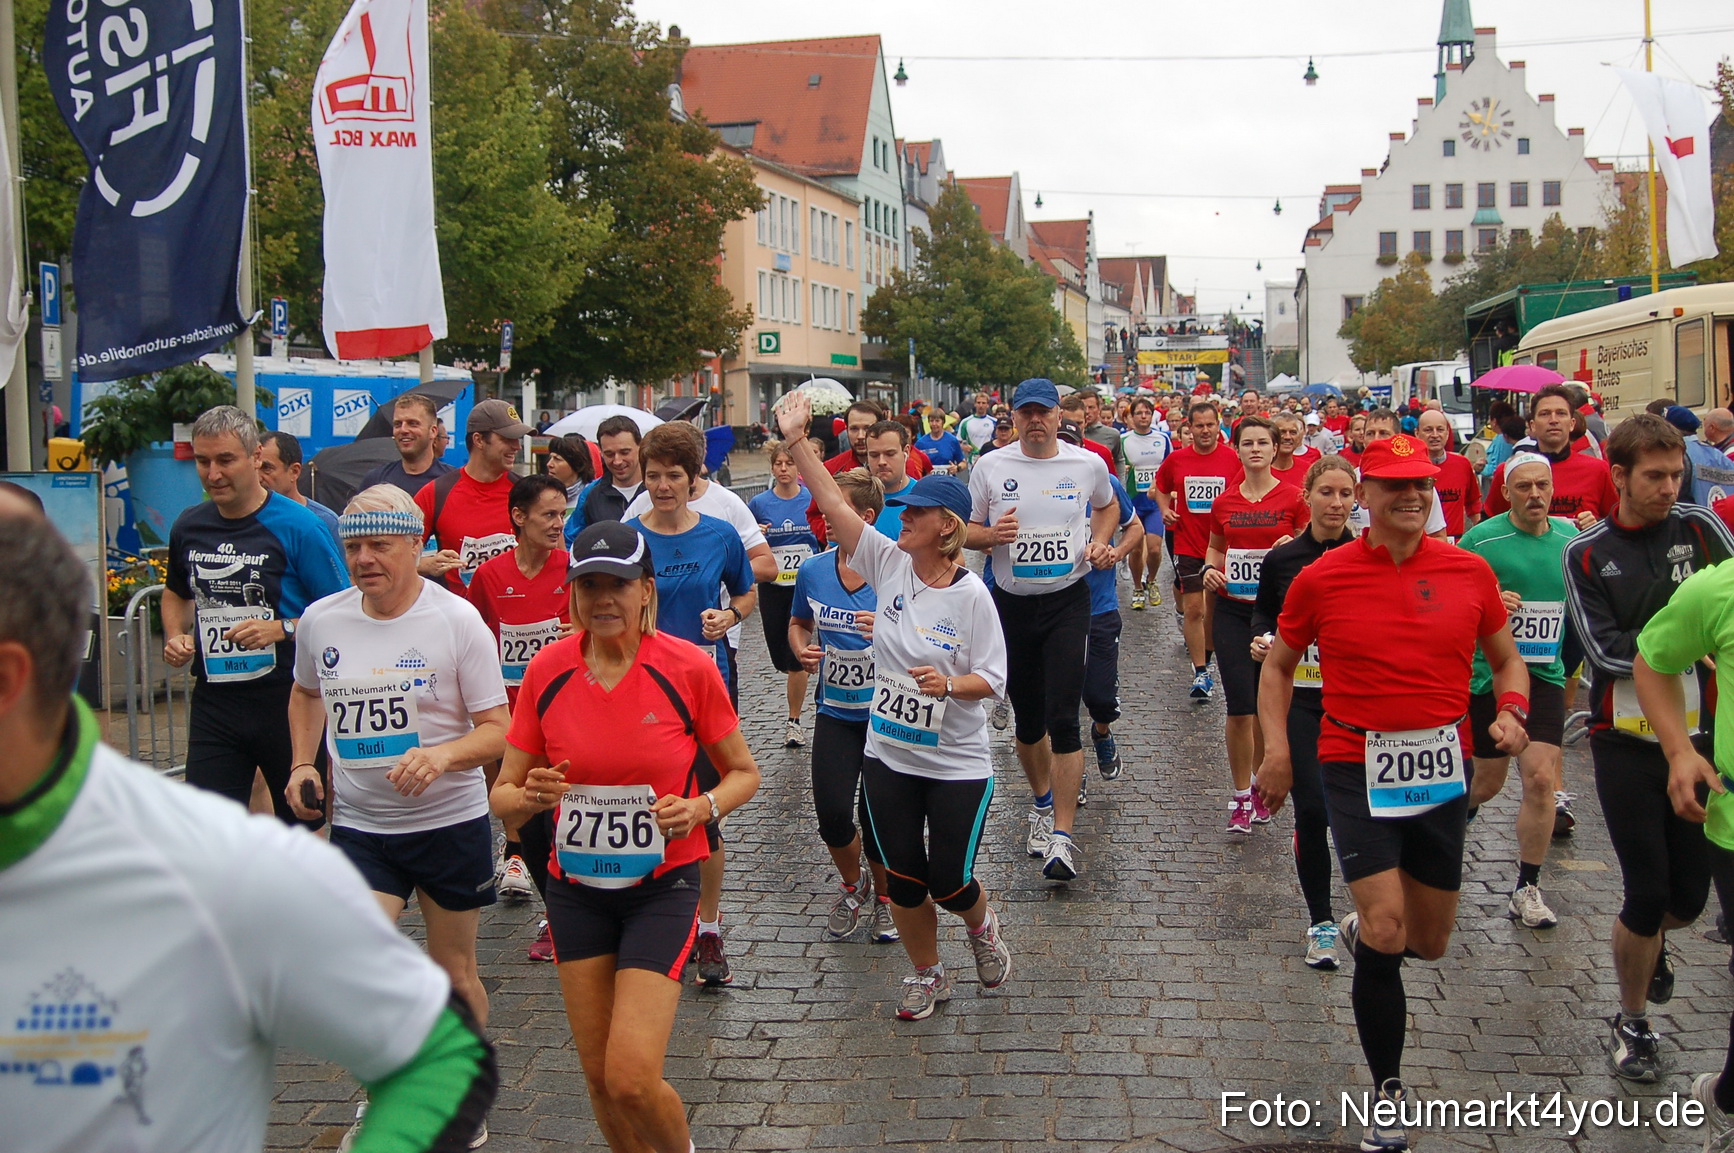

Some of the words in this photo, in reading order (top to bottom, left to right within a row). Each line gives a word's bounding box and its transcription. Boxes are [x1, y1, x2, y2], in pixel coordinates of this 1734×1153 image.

[45, 271, 56, 317] P
[275, 304, 284, 326] P
[761, 335, 777, 351] D
[1168, 353, 1198, 362] START
[1597, 339, 1648, 366] Bayerisches
[1597, 369, 1621, 387] Rotes
[1600, 395, 1620, 411] reuz
[1189, 486, 1221, 500] 2280
[217, 543, 236, 554] 40.
[1016, 540, 1069, 563] 2265
[188, 549, 265, 566] Hermannslauf
[665, 562, 700, 572] ERTEL
[1033, 567, 1053, 576] Jack
[1600, 568, 1621, 577] adidas
[1671, 561, 1694, 583] 44
[222, 614, 259, 622] Neumarkt
[885, 606, 900, 620] PARTL
[516, 627, 549, 637] Neumarkt
[1511, 616, 1560, 639] 2507
[207, 627, 266, 654] 25
[1519, 644, 1552, 656] Rüdiger
[225, 660, 248, 671] Mark
[1306, 668, 1322, 678] Nic
[828, 661, 875, 687] 2234
[878, 673, 898, 688] PARTL
[325, 688, 350, 697] PARTL
[351, 684, 397, 696] Neumarkt
[846, 692, 859, 701] Evi
[333, 697, 409, 734] 2755
[877, 688, 934, 728] 2431
[880, 722, 922, 742] Adelheid
[357, 740, 385, 755] Rudi
[1367, 739, 1400, 748] PARTL
[1402, 735, 1444, 747] Neumarkt
[1376, 747, 1454, 783] 2099
[562, 793, 590, 805] PARTL
[591, 796, 643, 806] Neumarkt
[1405, 789, 1430, 803] Karl
[566, 809, 654, 849] 2756
[592, 859, 621, 874] Jina
